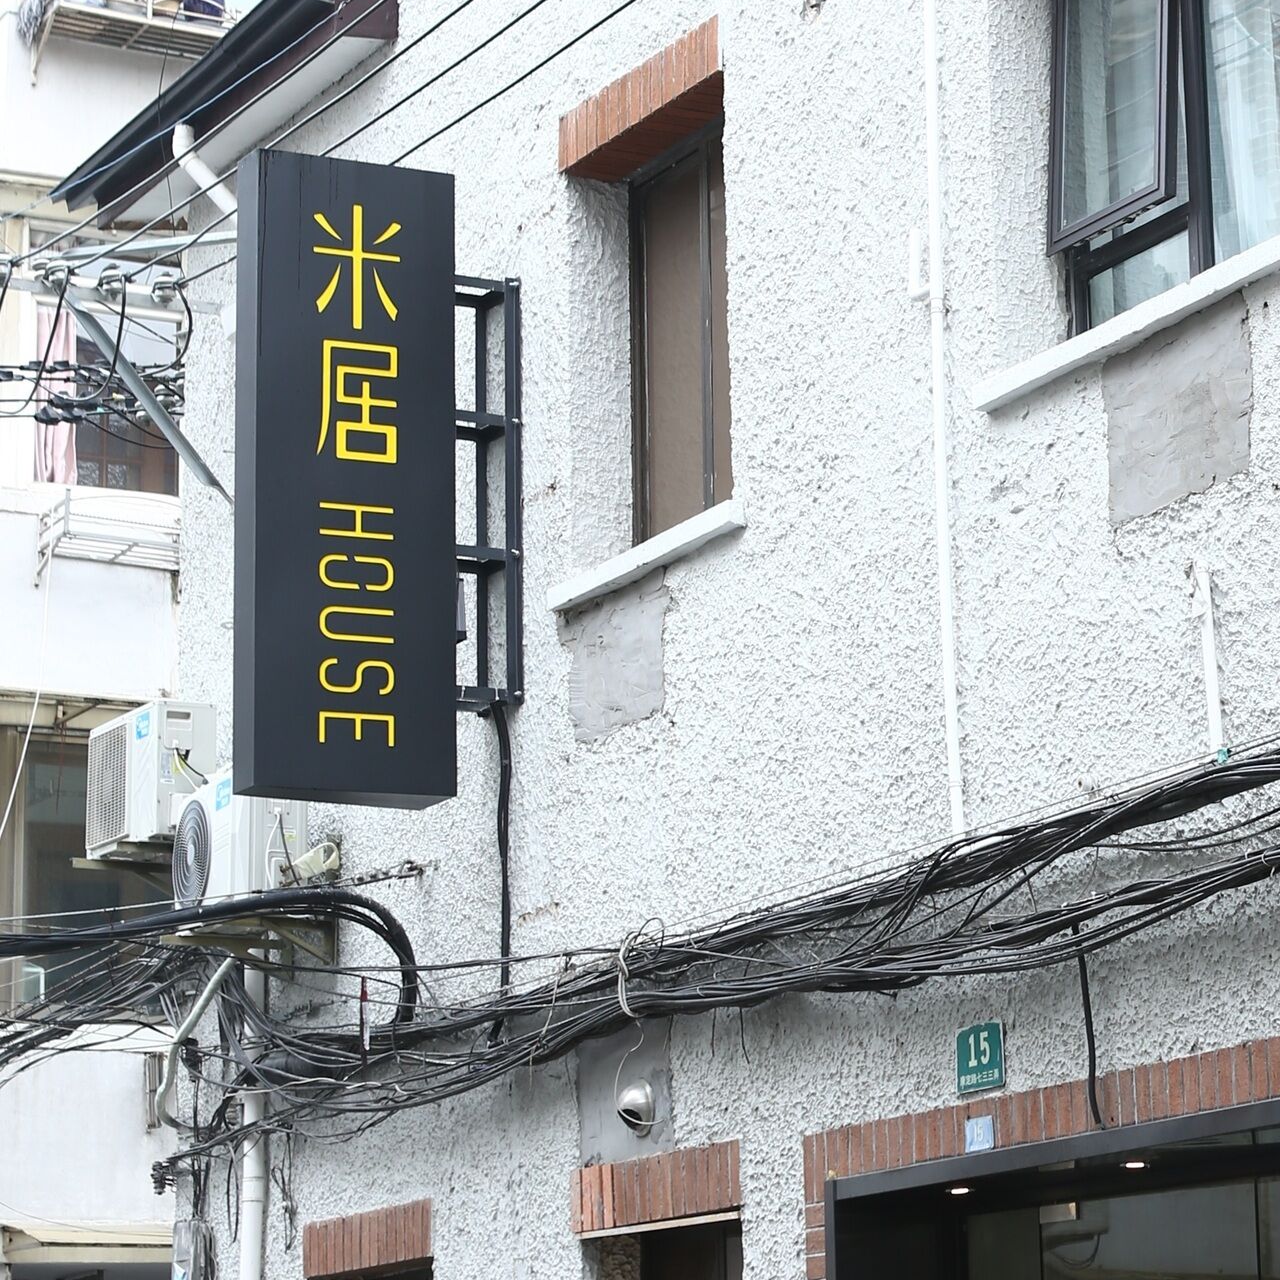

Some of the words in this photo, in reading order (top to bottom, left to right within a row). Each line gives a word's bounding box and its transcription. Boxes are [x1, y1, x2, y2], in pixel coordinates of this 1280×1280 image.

[313, 204, 402, 465] 米居
[318, 500, 396, 749] HOUSE
[968, 1030, 991, 1068] 15
[974, 1124, 984, 1142] 15
